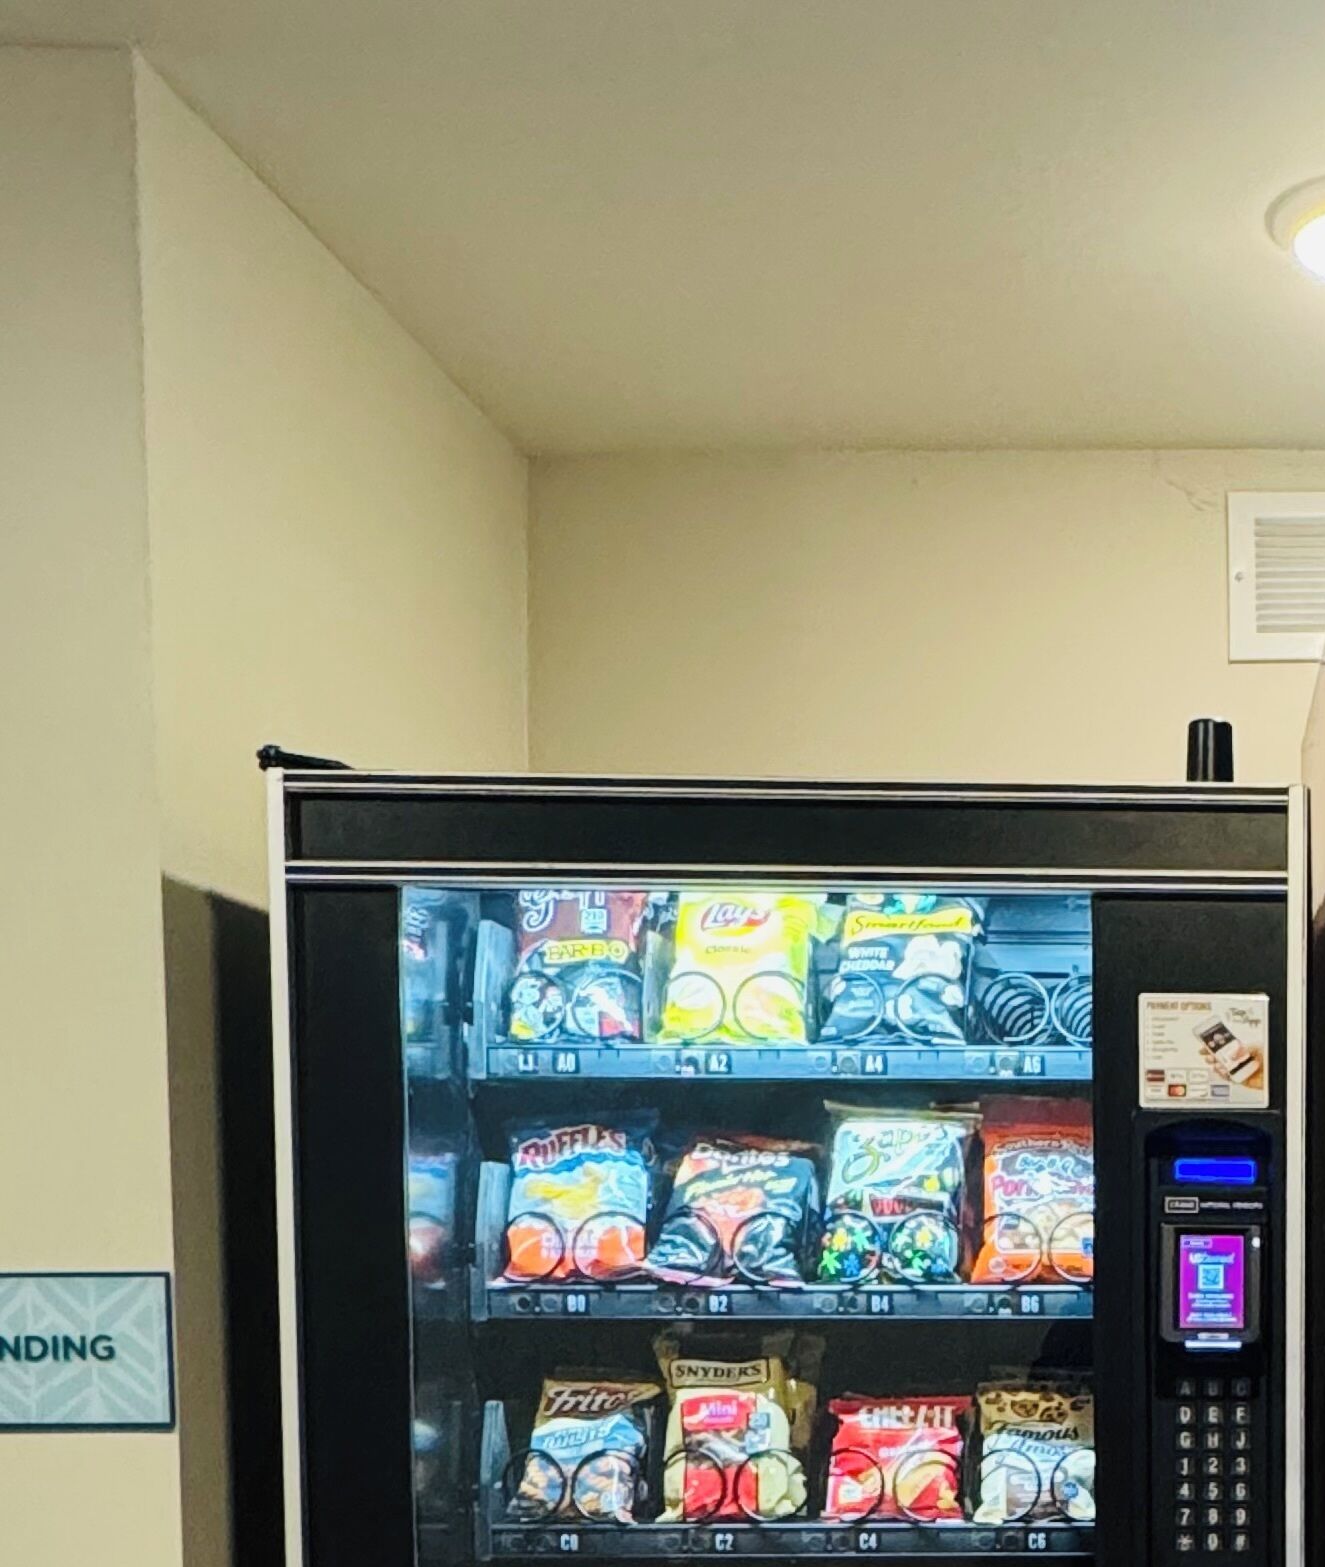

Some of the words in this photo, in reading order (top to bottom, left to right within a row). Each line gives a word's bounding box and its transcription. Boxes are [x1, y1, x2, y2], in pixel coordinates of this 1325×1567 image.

[848, 946, 890, 960] WHITE
[708, 1053, 729, 1073] A2
[864, 1054, 884, 1074] A4
[1022, 1055, 1043, 1074] A6
[516, 1122, 627, 1169] RUFFLES
[690, 1142, 791, 1174] Doritos
[567, 1293, 587, 1313] B0
[708, 1293, 729, 1313] B2
[871, 1295, 889, 1313] B4
[1021, 1294, 1040, 1313] B6
[0, 1334, 117, 1363] NDING
[698, 1399, 738, 1417] Mini
[992, 1421, 1080, 1443] Famous
[560, 1534, 580, 1551] C0
[715, 1533, 734, 1551] C2
[859, 1533, 878, 1550] C4
[1028, 1532, 1047, 1550] C6
